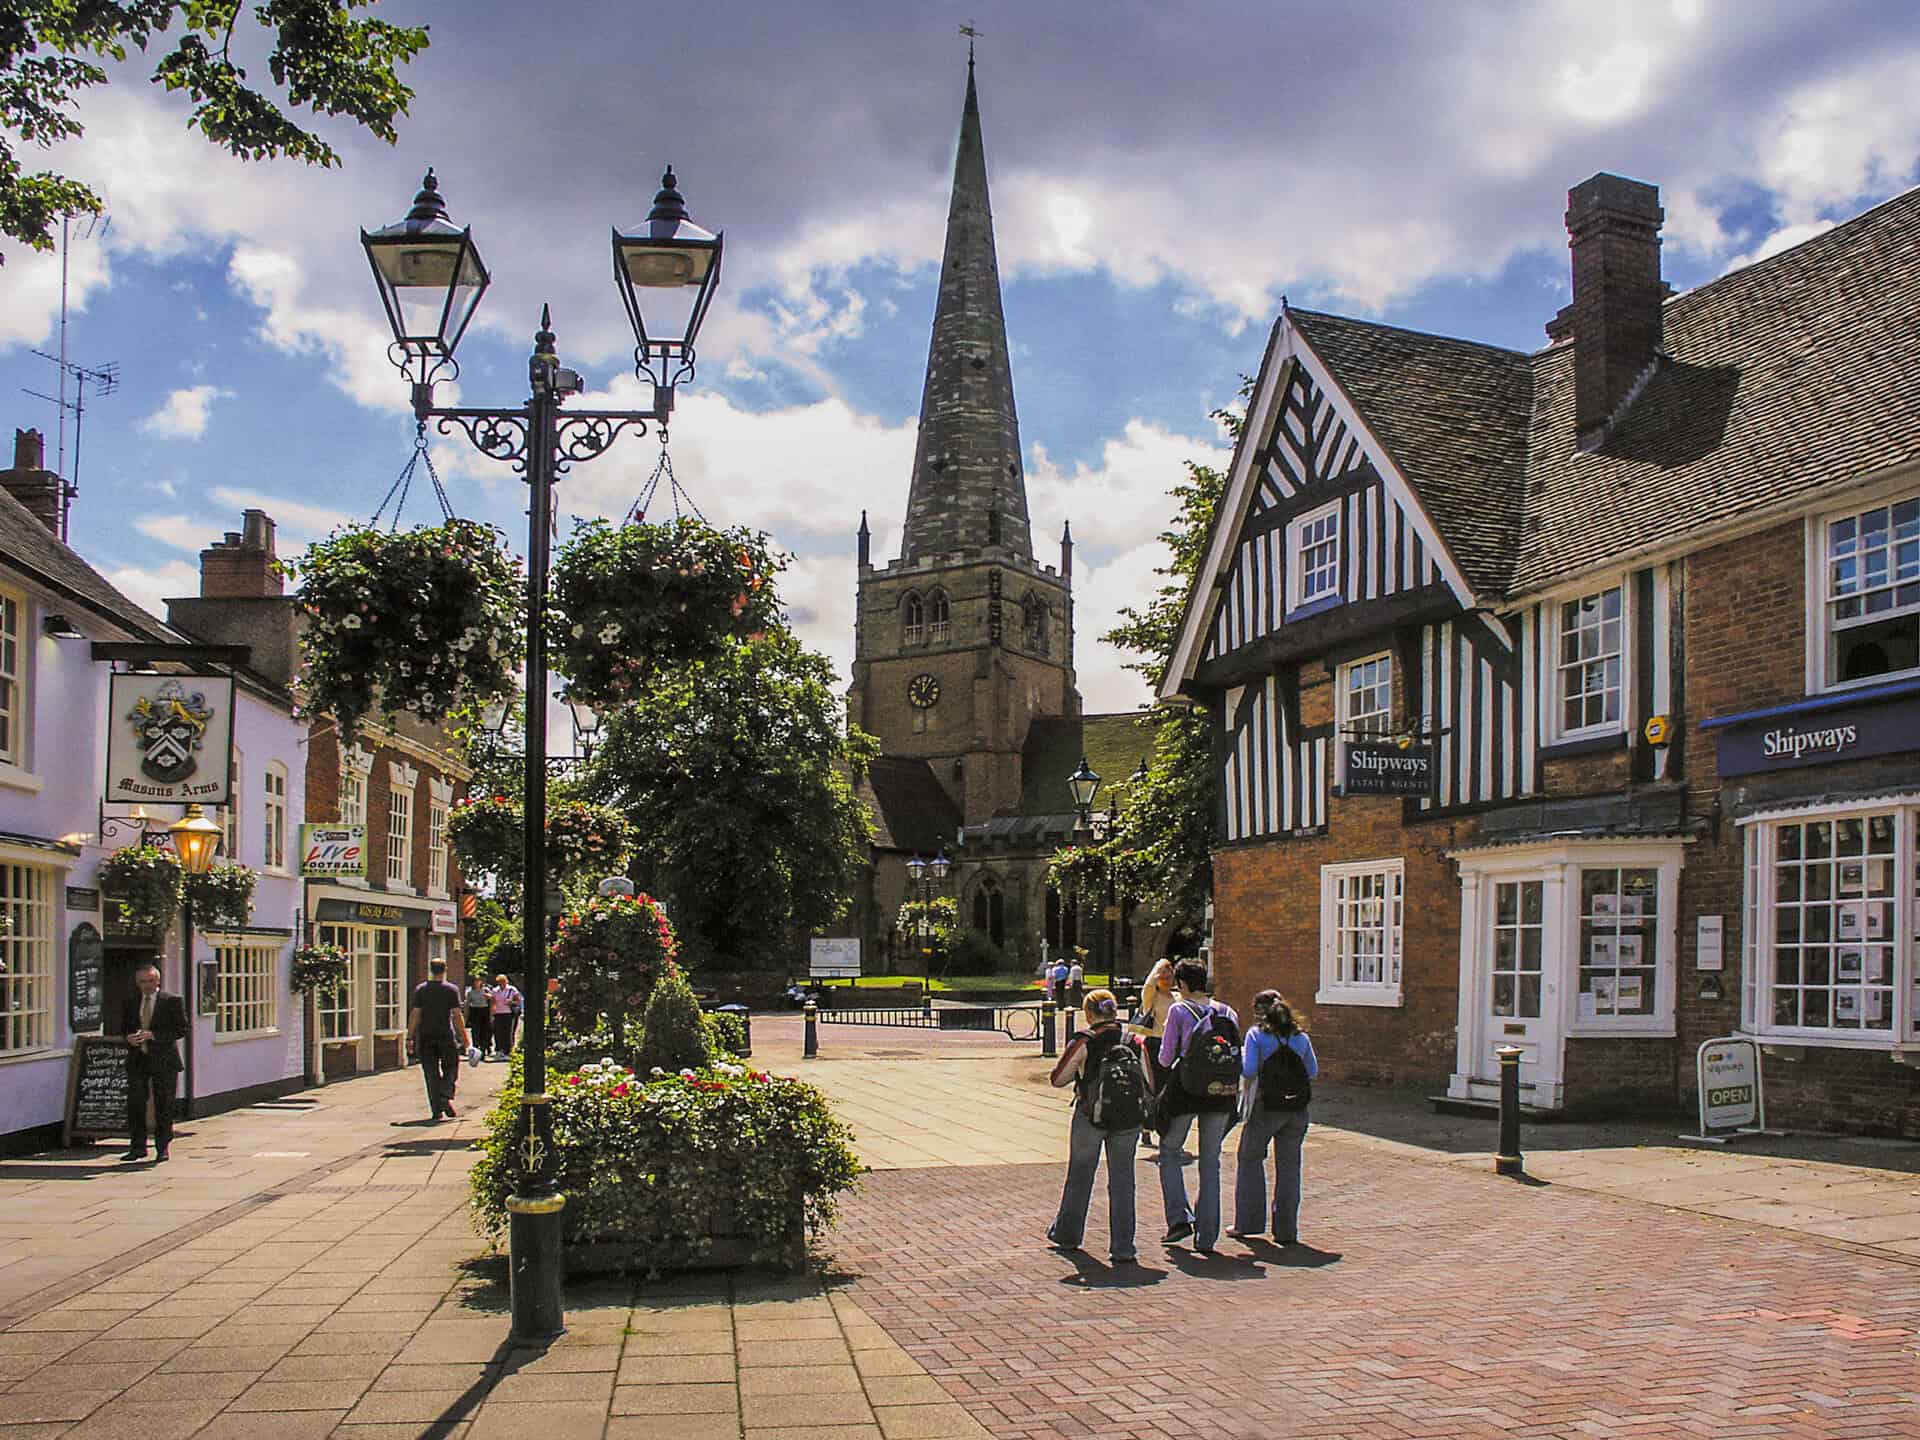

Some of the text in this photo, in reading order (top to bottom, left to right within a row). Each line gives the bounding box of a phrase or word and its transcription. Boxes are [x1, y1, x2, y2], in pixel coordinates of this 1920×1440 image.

[1764, 725, 1857, 758] Shipways
[1351, 750, 1428, 776] Shipways
[118, 778, 219, 797] Masons Arms
[1350, 778, 1429, 790] ESTATE AGENTS
[305, 844, 361, 863] Live
[1711, 1089, 1749, 1105] OPEN
